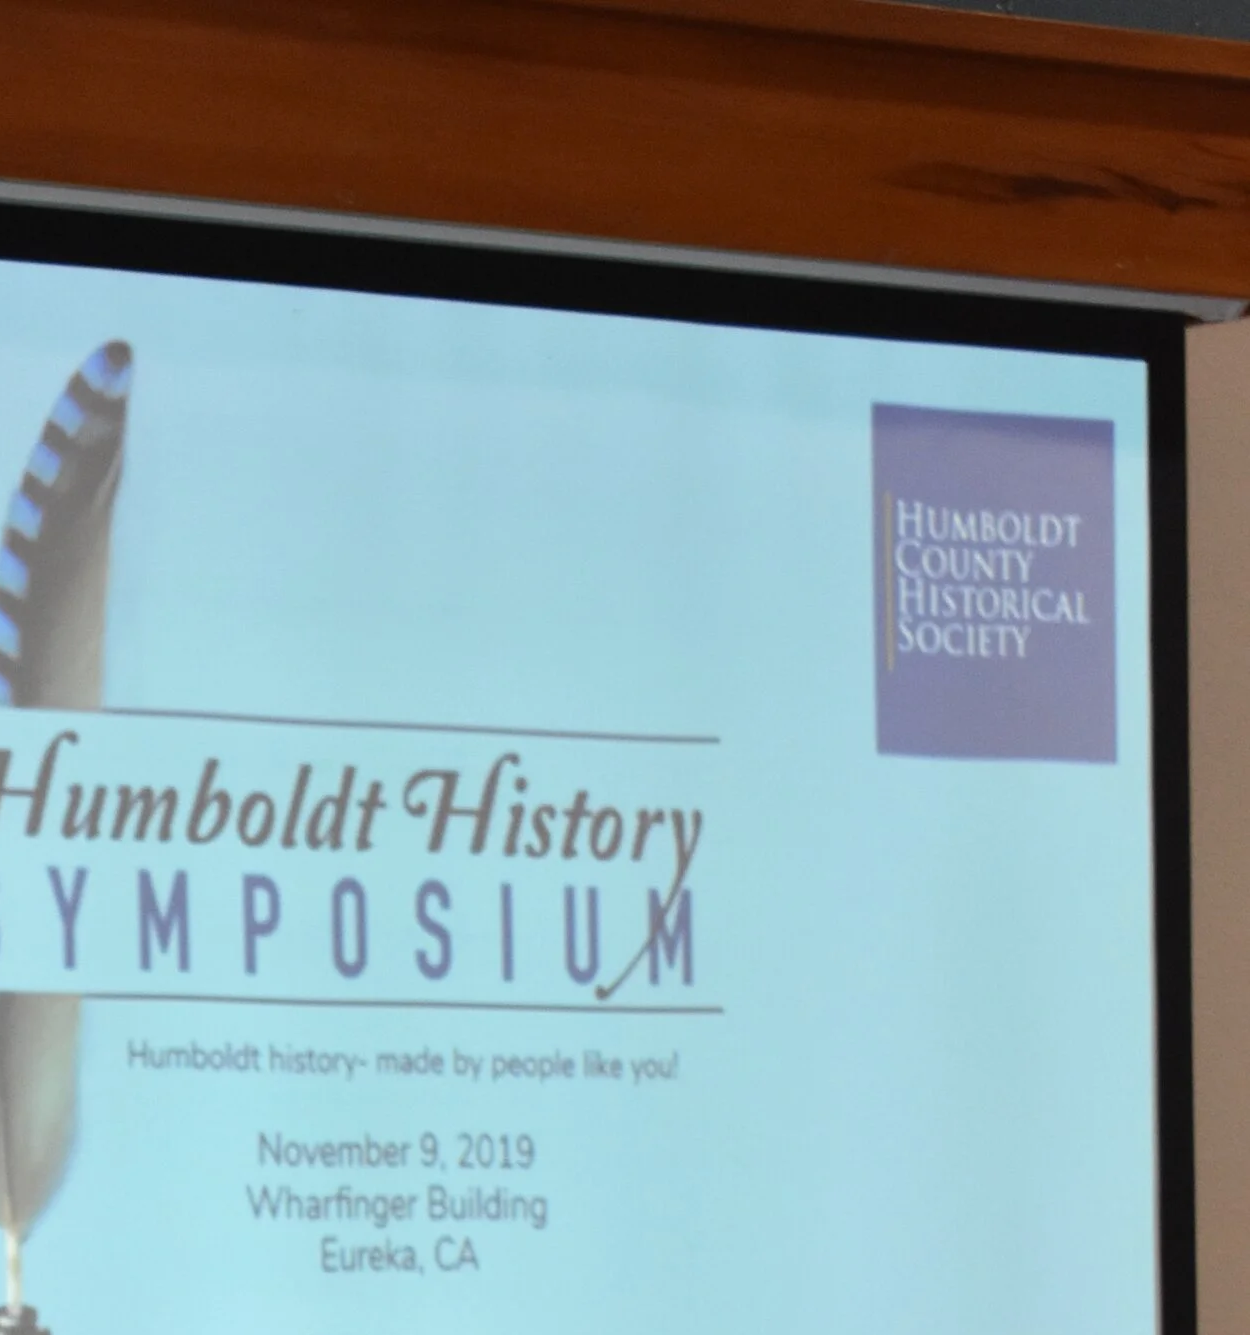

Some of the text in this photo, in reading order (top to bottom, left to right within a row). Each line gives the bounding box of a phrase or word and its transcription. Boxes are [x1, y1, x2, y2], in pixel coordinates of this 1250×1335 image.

[897, 498, 1082, 547] HUMBOLDT
[895, 539, 1034, 583] COUNTY
[898, 577, 1090, 624] HISTORICAL
[898, 616, 1031, 658] SOCIETY
[126, 1040, 259, 1073] Humboldt
[376, 1045, 445, 1077] made
[453, 1046, 483, 1083] by
[491, 1049, 575, 1083] people
[583, 1050, 623, 1079] like
[630, 1051, 681, 1085] you!
[257, 1131, 536, 1172] November 9, 2019
[246, 1184, 549, 1229] Wharfinger Building
[320, 1236, 480, 1276] Eureka, CA
